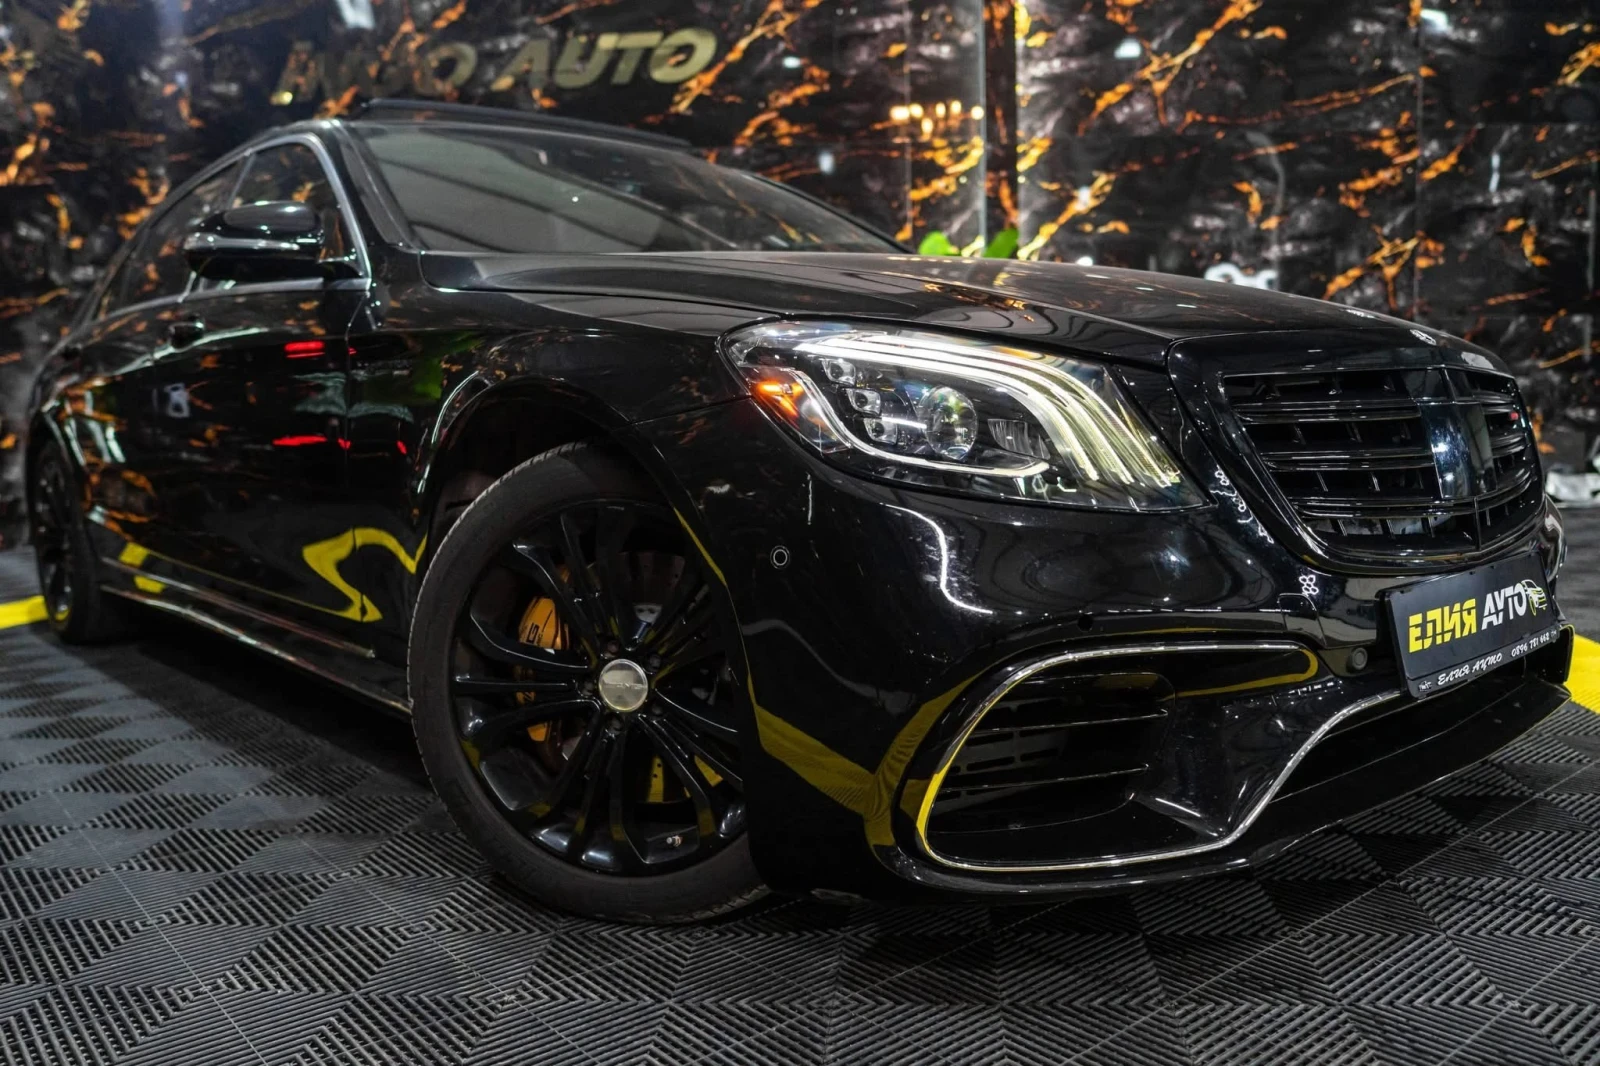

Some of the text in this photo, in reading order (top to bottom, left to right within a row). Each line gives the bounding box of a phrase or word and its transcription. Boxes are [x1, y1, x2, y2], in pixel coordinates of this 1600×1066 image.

[491, 28, 717, 88] AUTO
[1409, 598, 1477, 653] ЕЛИЯ
[1511, 642, 1528, 657] 0896
